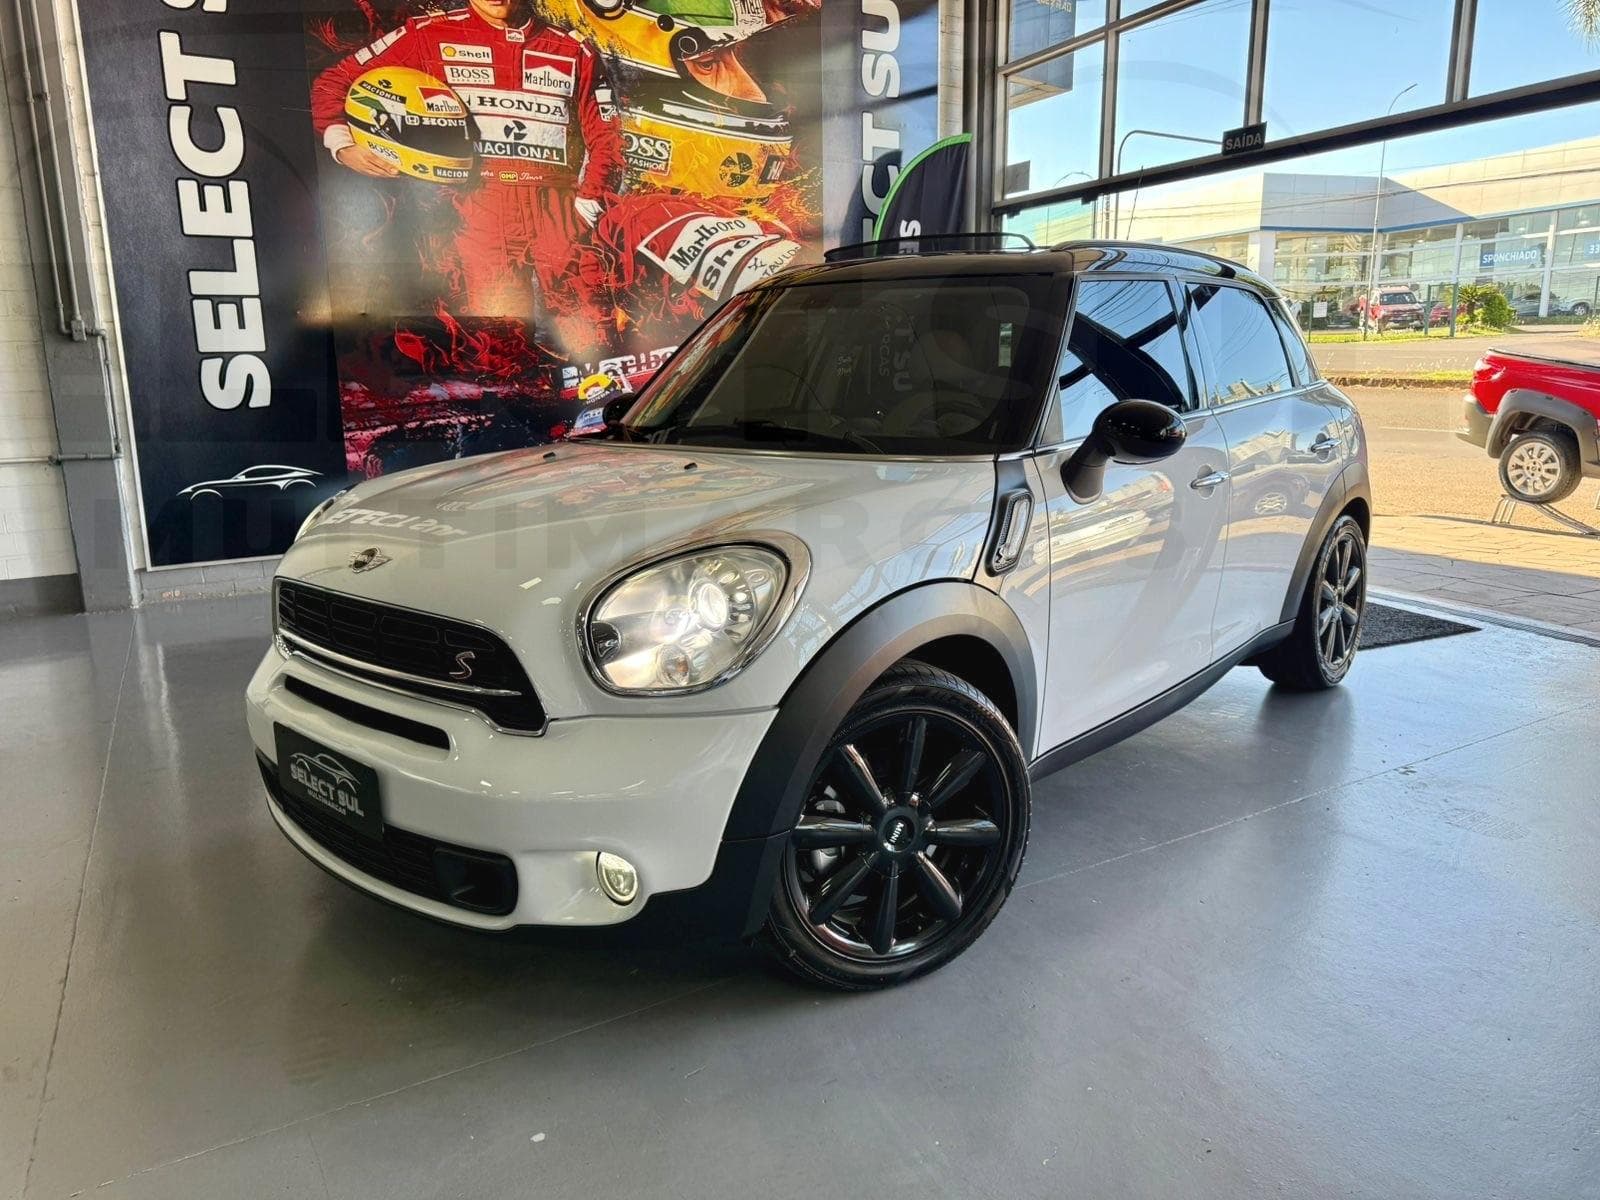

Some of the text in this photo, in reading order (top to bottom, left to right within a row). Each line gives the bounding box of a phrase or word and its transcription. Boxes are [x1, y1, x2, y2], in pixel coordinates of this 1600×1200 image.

[458, 50, 490, 59] Shell
[862, 0, 900, 98] SU
[450, 67, 490, 79] BOSS
[524, 70, 571, 90] Marlboro
[362, 82, 402, 102] NACIONAL
[477, 95, 566, 118] HONDA
[422, 117, 465, 127] HOND
[623, 132, 670, 160] OSS
[1225, 132, 1261, 151] SAÍDA
[436, 168, 469, 178] NACION
[628, 157, 666, 171] FASHION
[159, 30, 271, 409] SELECT
[669, 219, 746, 270] Marlboro
[1482, 249, 1537, 264] SPONCHIADO
[449, 650, 475, 680] S
[290, 763, 365, 817] SELECT SUL
